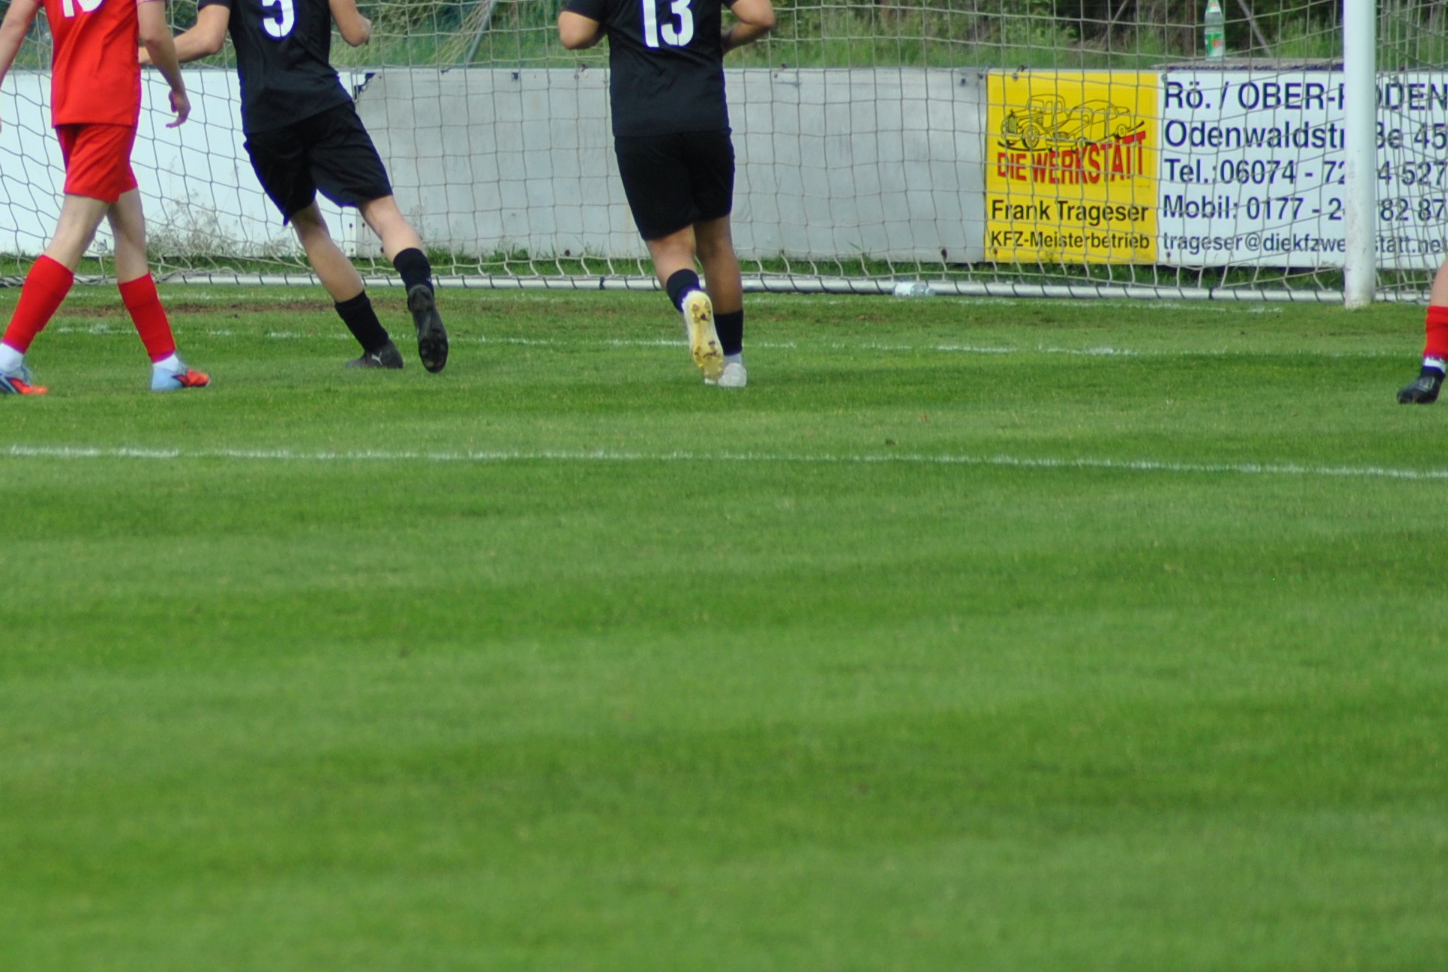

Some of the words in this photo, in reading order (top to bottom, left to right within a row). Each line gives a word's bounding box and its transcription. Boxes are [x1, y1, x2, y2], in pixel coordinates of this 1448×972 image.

[1165, 81, 1211, 110] Rö.
[1238, 82, 1448, 111] OBER-DEN
[1413, 122, 1448, 150] 45
[997, 151, 1027, 181] DIE
[1031, 130, 1146, 185] WERKSTATT
[1401, 161, 1448, 186] 527
[991, 199, 1051, 221] Frank
[1057, 200, 1149, 227] Trageser
[1163, 194, 1239, 220] Mobil:
[1246, 196, 1305, 220] 0177
[1380, 199, 1409, 222] 82
[1418, 198, 1447, 222] 87
[991, 230, 1150, 250] KFZ-Meisterbetrieb
